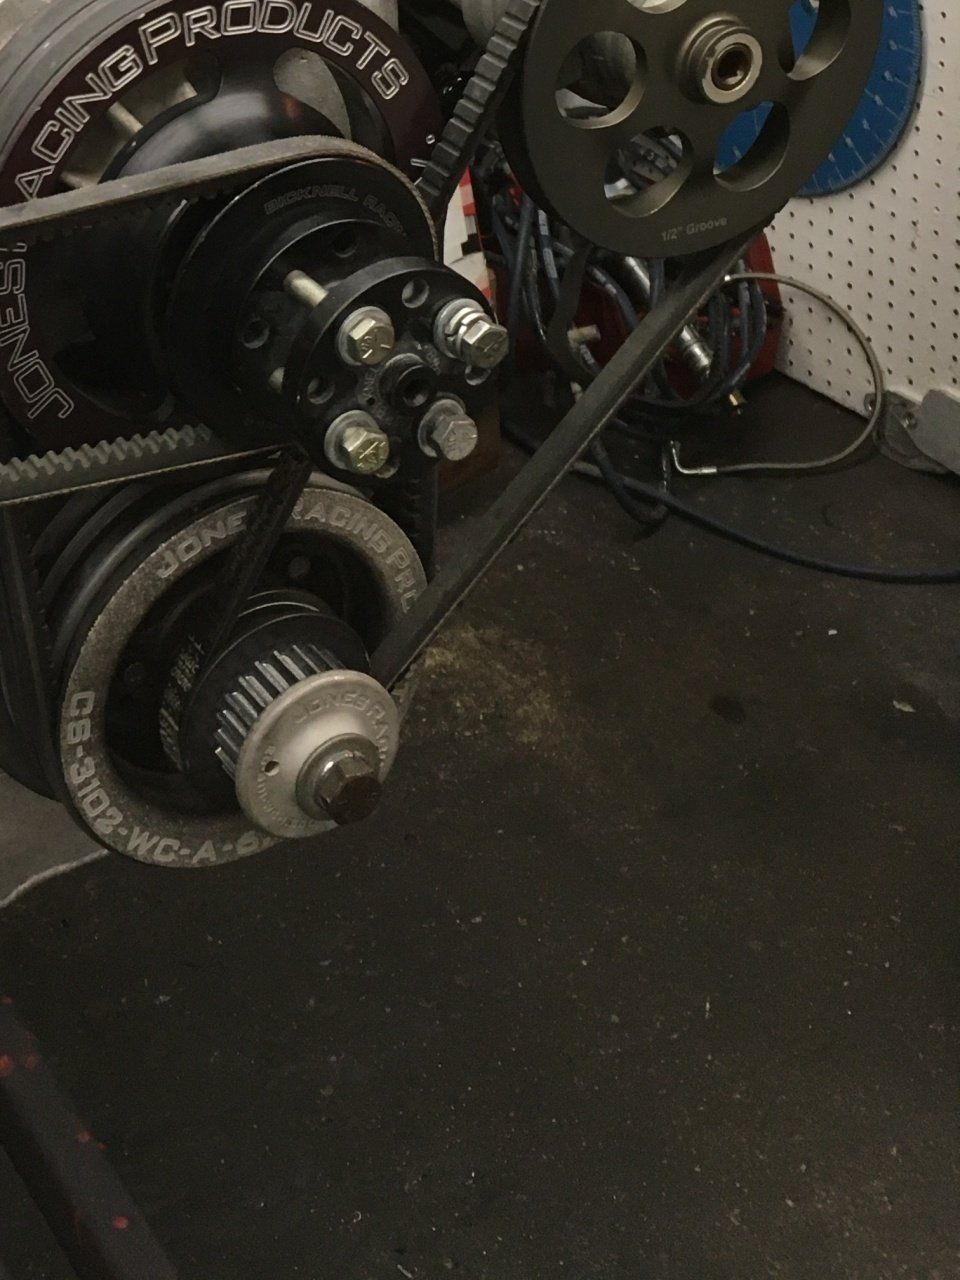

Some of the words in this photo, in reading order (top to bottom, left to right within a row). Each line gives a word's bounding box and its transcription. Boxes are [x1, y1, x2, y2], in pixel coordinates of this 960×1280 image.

[15, 45, 143, 202] ACING
[264, 184, 358, 215] BICKNELL
[686, 217, 728, 235] Groove
[157, 508, 248, 580] JONE
